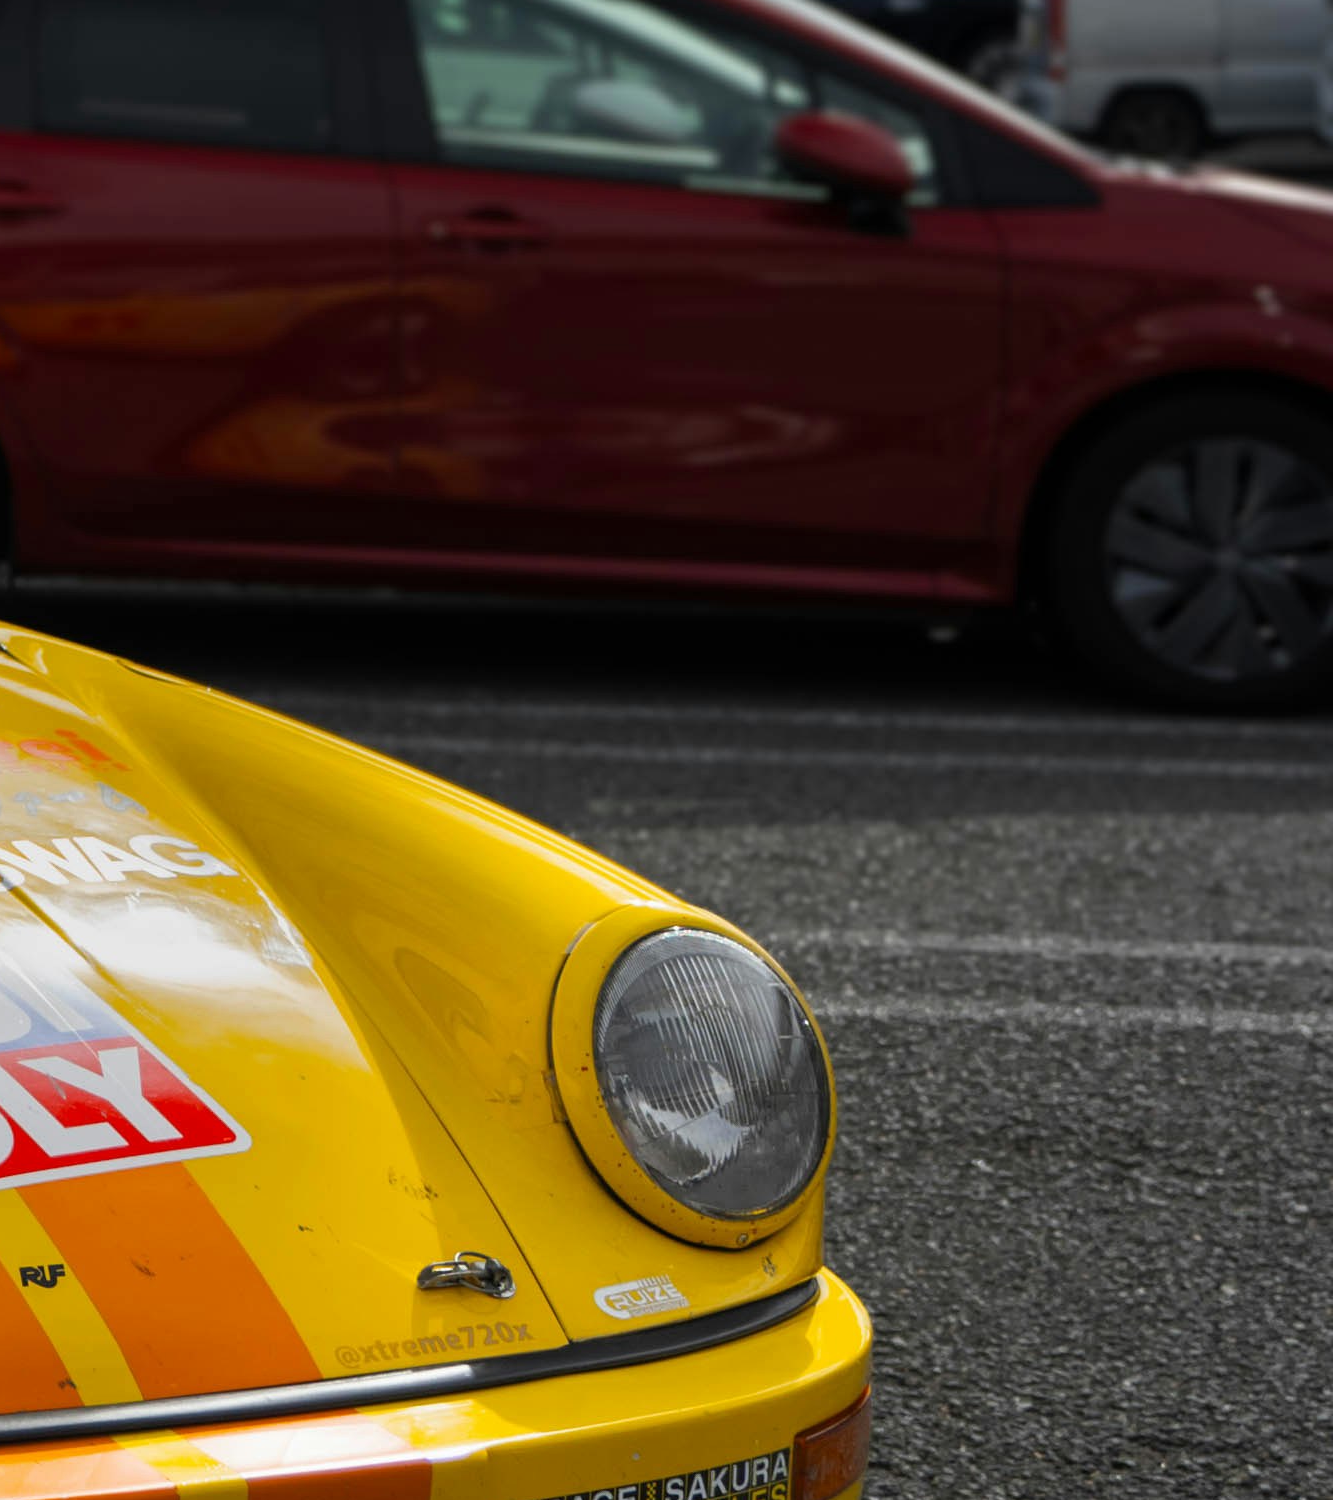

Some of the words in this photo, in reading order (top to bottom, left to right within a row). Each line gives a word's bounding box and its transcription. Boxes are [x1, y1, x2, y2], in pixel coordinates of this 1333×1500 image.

[19, 1262, 67, 1289] RUF
[594, 1273, 683, 1320] CRUIZE
[334, 1321, 533, 1370] @xtreme720x
